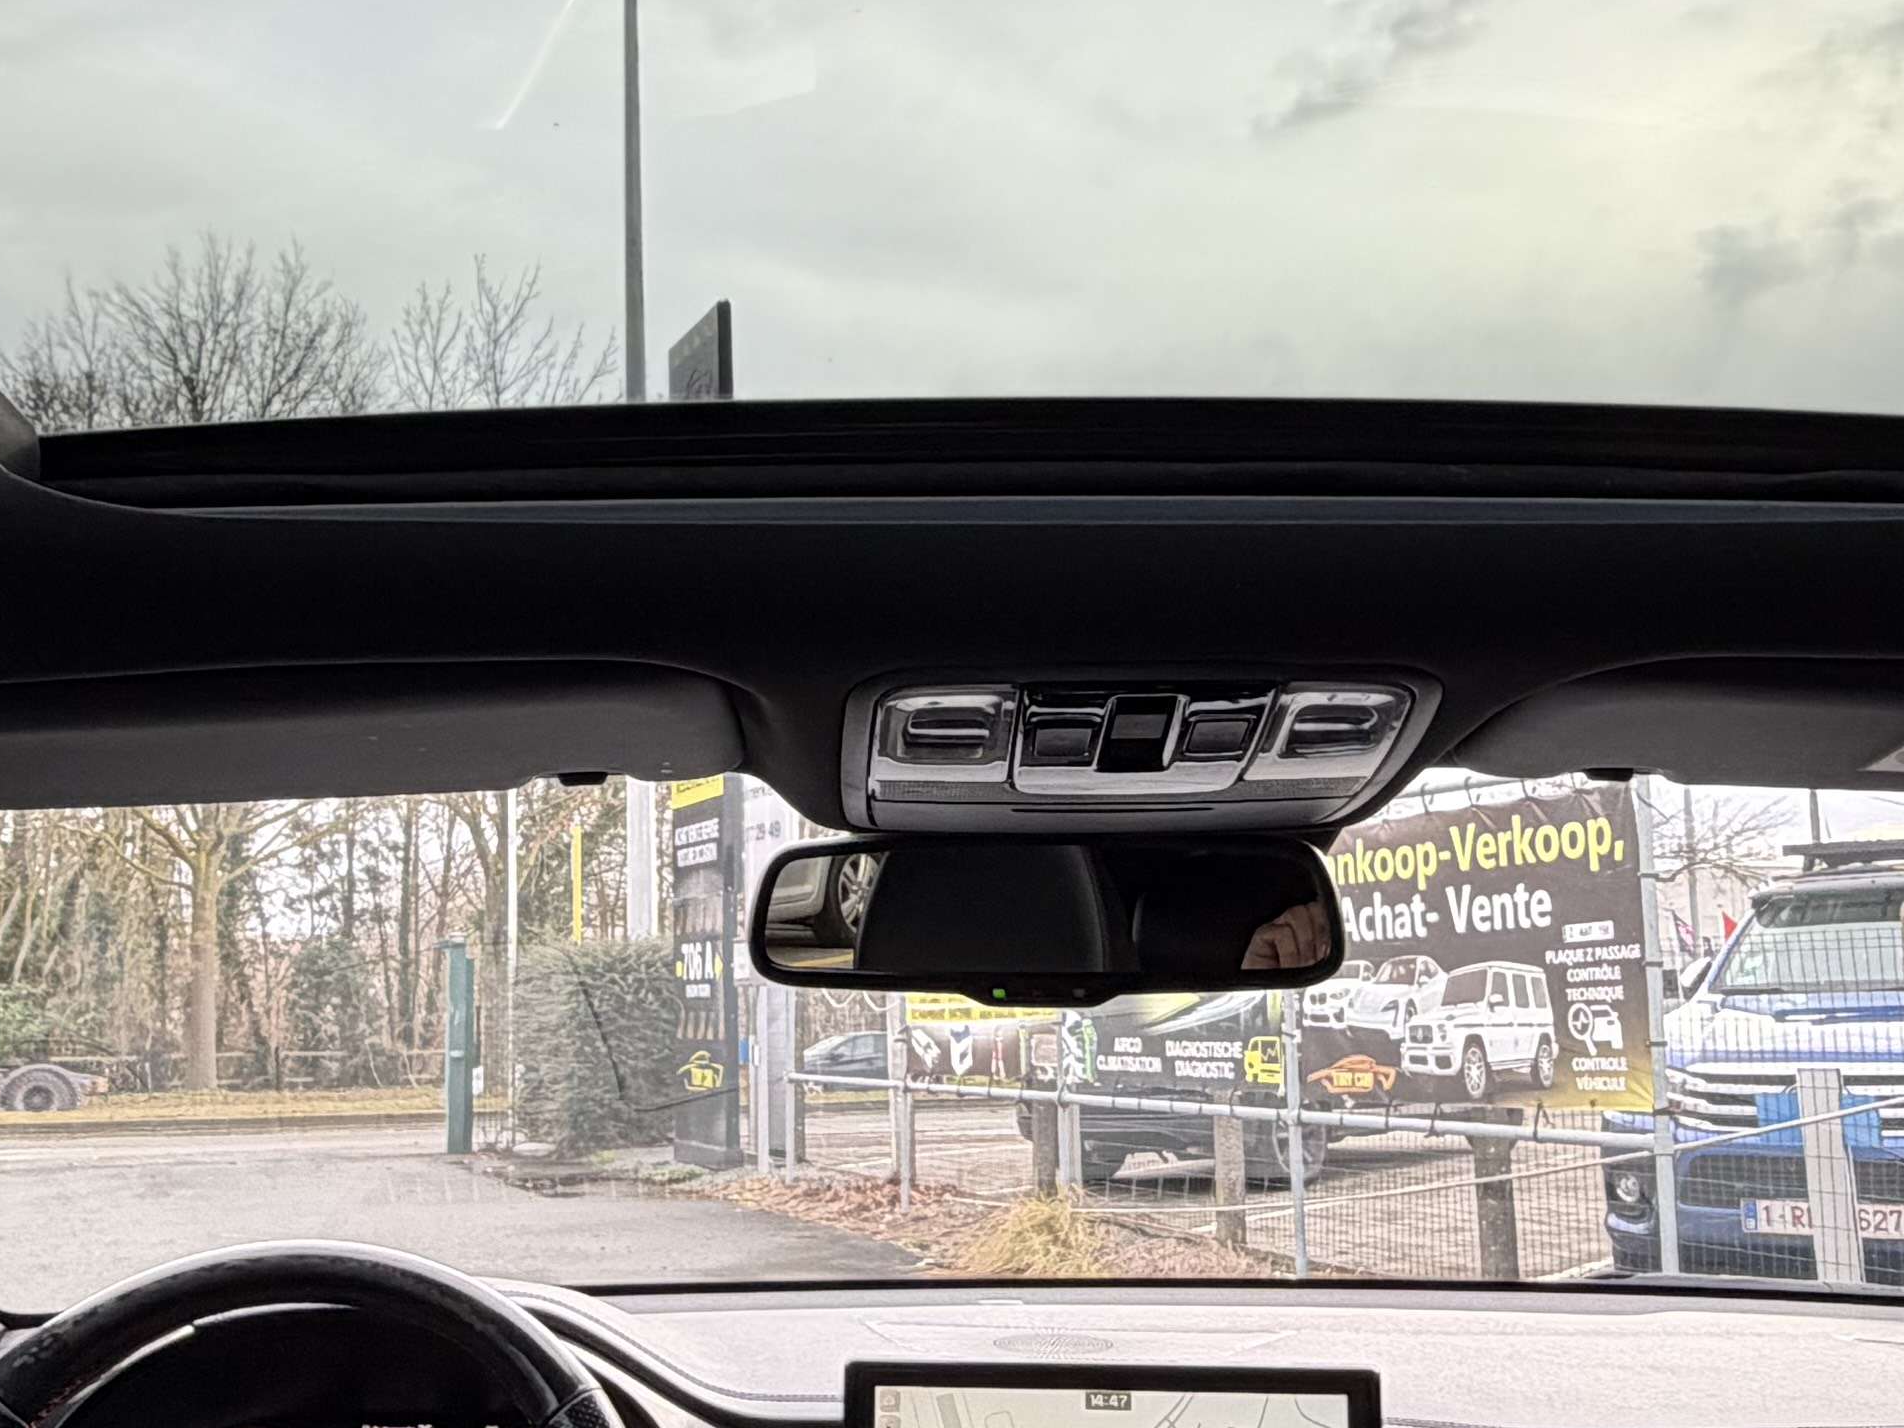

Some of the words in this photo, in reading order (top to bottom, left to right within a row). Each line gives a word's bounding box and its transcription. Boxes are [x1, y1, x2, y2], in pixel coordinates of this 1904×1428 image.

[1341, 891, 1440, 942] Achat-
[1446, 883, 1553, 933] Vente
[704, 941, 714, 980] A
[1545, 948, 1585, 966] PLAQUE
[1595, 944, 1641, 960] PASSAGE
[1565, 985, 1625, 1002] TECHNIQUE
[1090, 1394, 1128, 1408] 14:47
